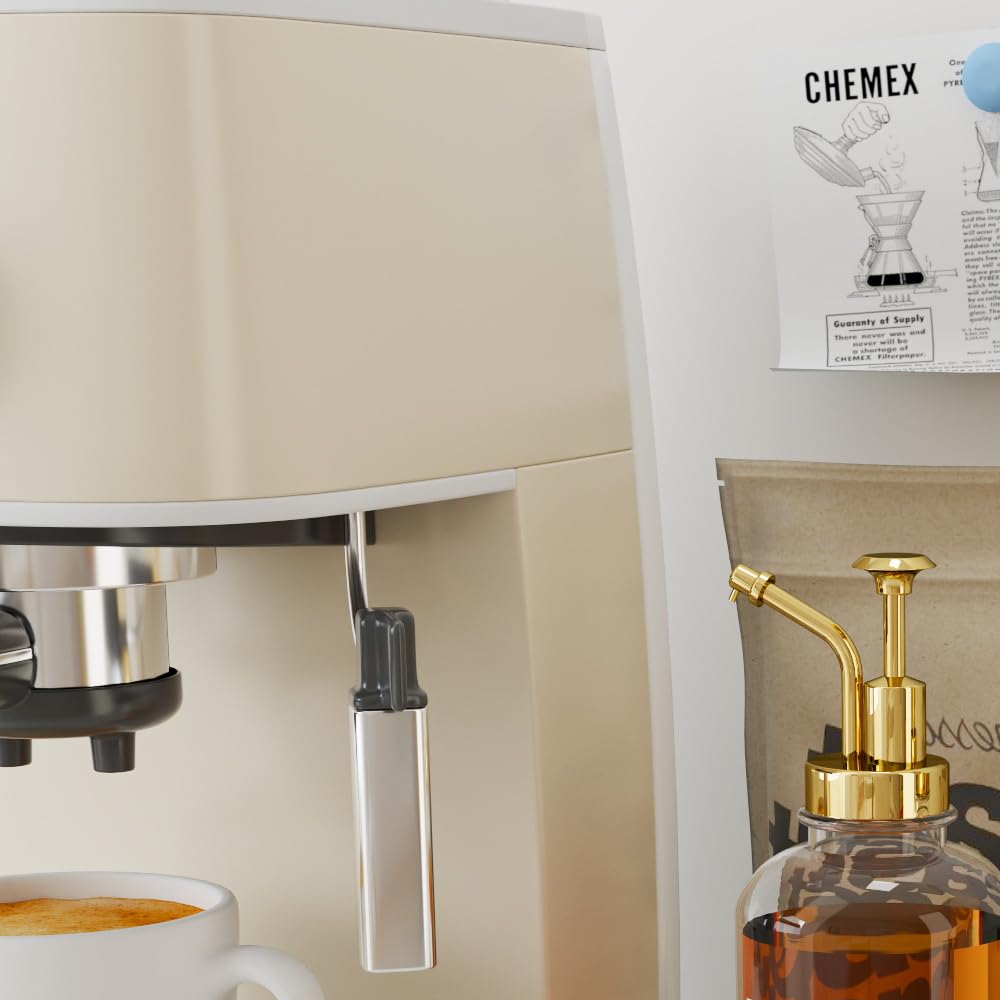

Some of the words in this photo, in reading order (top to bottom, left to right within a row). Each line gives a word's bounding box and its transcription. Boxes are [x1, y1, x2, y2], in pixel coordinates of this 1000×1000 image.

[804, 62, 919, 104] CHEMEX
[834, 319, 876, 329] Guaranty
[894, 314, 924, 324] Supply
